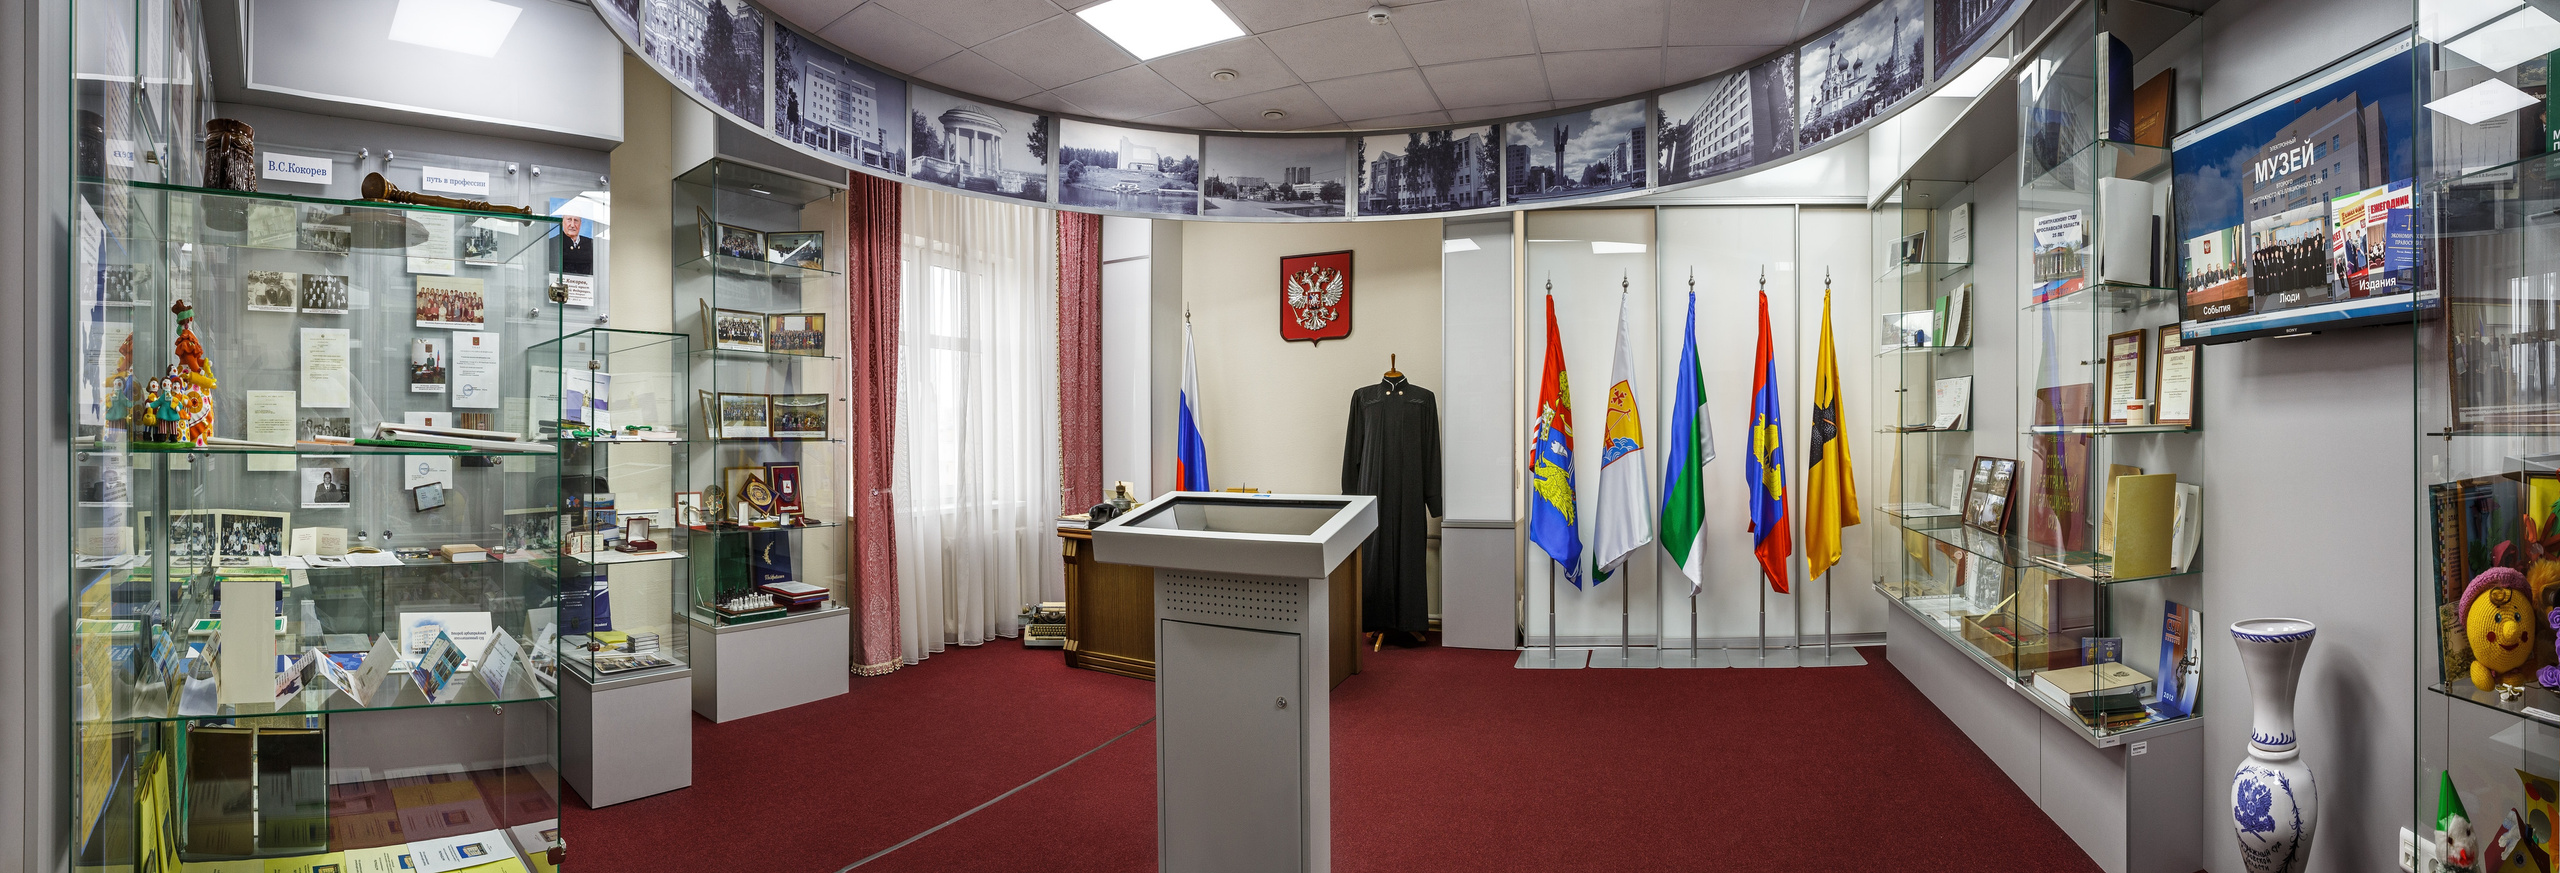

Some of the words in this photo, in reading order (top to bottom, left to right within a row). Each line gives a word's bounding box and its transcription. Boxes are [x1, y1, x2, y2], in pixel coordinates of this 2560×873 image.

[2269, 137, 2297, 152] ЭЛЕКТРОННЫЙ
[2254, 138, 2315, 183] МУЗЕЙ
[268, 160, 327, 177] В.С.Кокорев
[426, 176, 442, 184] путь
[450, 178, 486, 188] профессии
[2276, 178, 2293, 189] ВТОРОГО
[2370, 195, 2410, 214] ЕЖЕГОДНИК
[2063, 221, 2080, 229] ОБЛАСТИ
[2359, 277, 2397, 291] Издания
[2279, 292, 2301, 303] Люди
[2203, 304, 2231, 315] События
[2047, 453, 2068, 469] ВТОРОЙ
[2036, 474, 2079, 492] АРБИТРАЖНЫЙ
[2047, 514, 2058, 531] СУД
[2166, 618, 2182, 636] СУД
[2163, 691, 2174, 701] 2012
